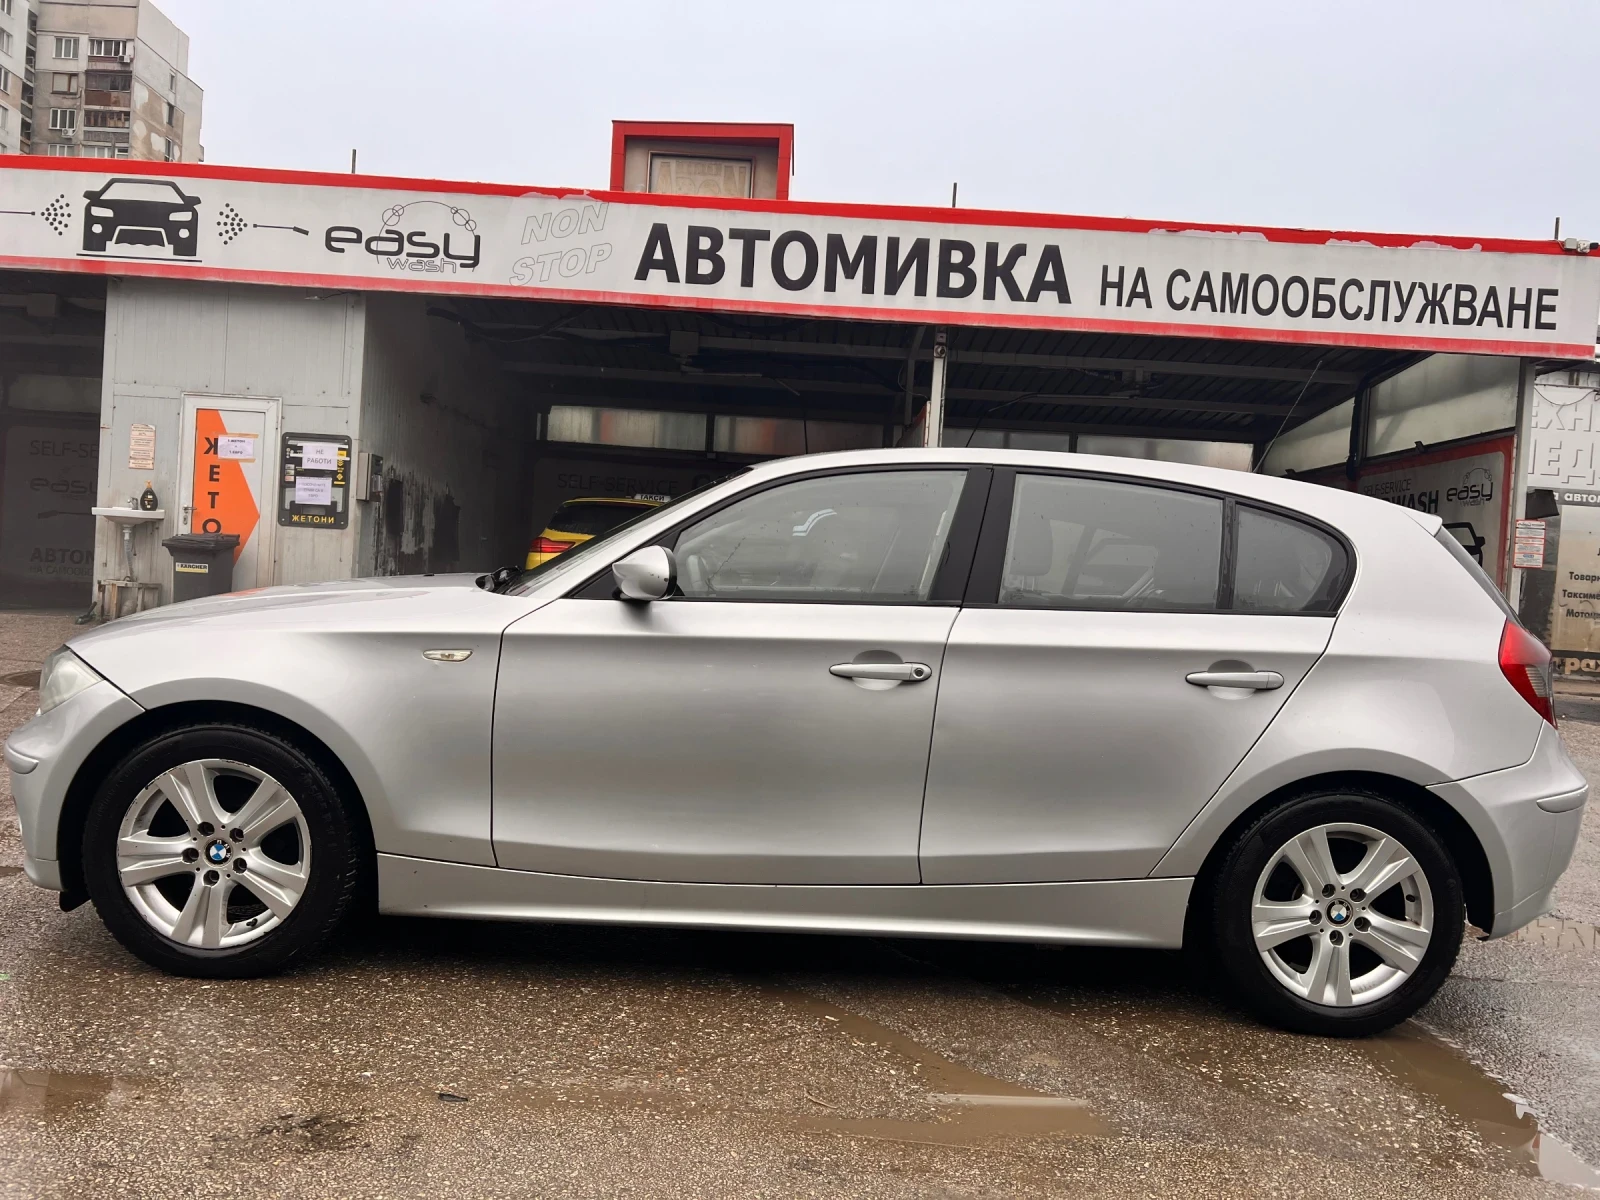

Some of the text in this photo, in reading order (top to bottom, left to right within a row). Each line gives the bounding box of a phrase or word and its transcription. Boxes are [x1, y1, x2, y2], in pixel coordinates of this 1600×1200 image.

[520, 202, 610, 245] NON
[324, 225, 481, 269] easy
[386, 257, 457, 274] wash
[508, 242, 613, 286] STOP
[634, 222, 1072, 304] АВТОМИВКА
[1099, 264, 1559, 331] НА САМООБСЛУЖВАНЕ
[306, 457, 332, 465] РАБОТИ
[557, 473, 679, 496] SELF-SERVICE
[1446, 482, 1494, 502] easy
[640, 494, 665, 502] ТАКСИ
[291, 514, 335, 524] ЖЕТОНИ
